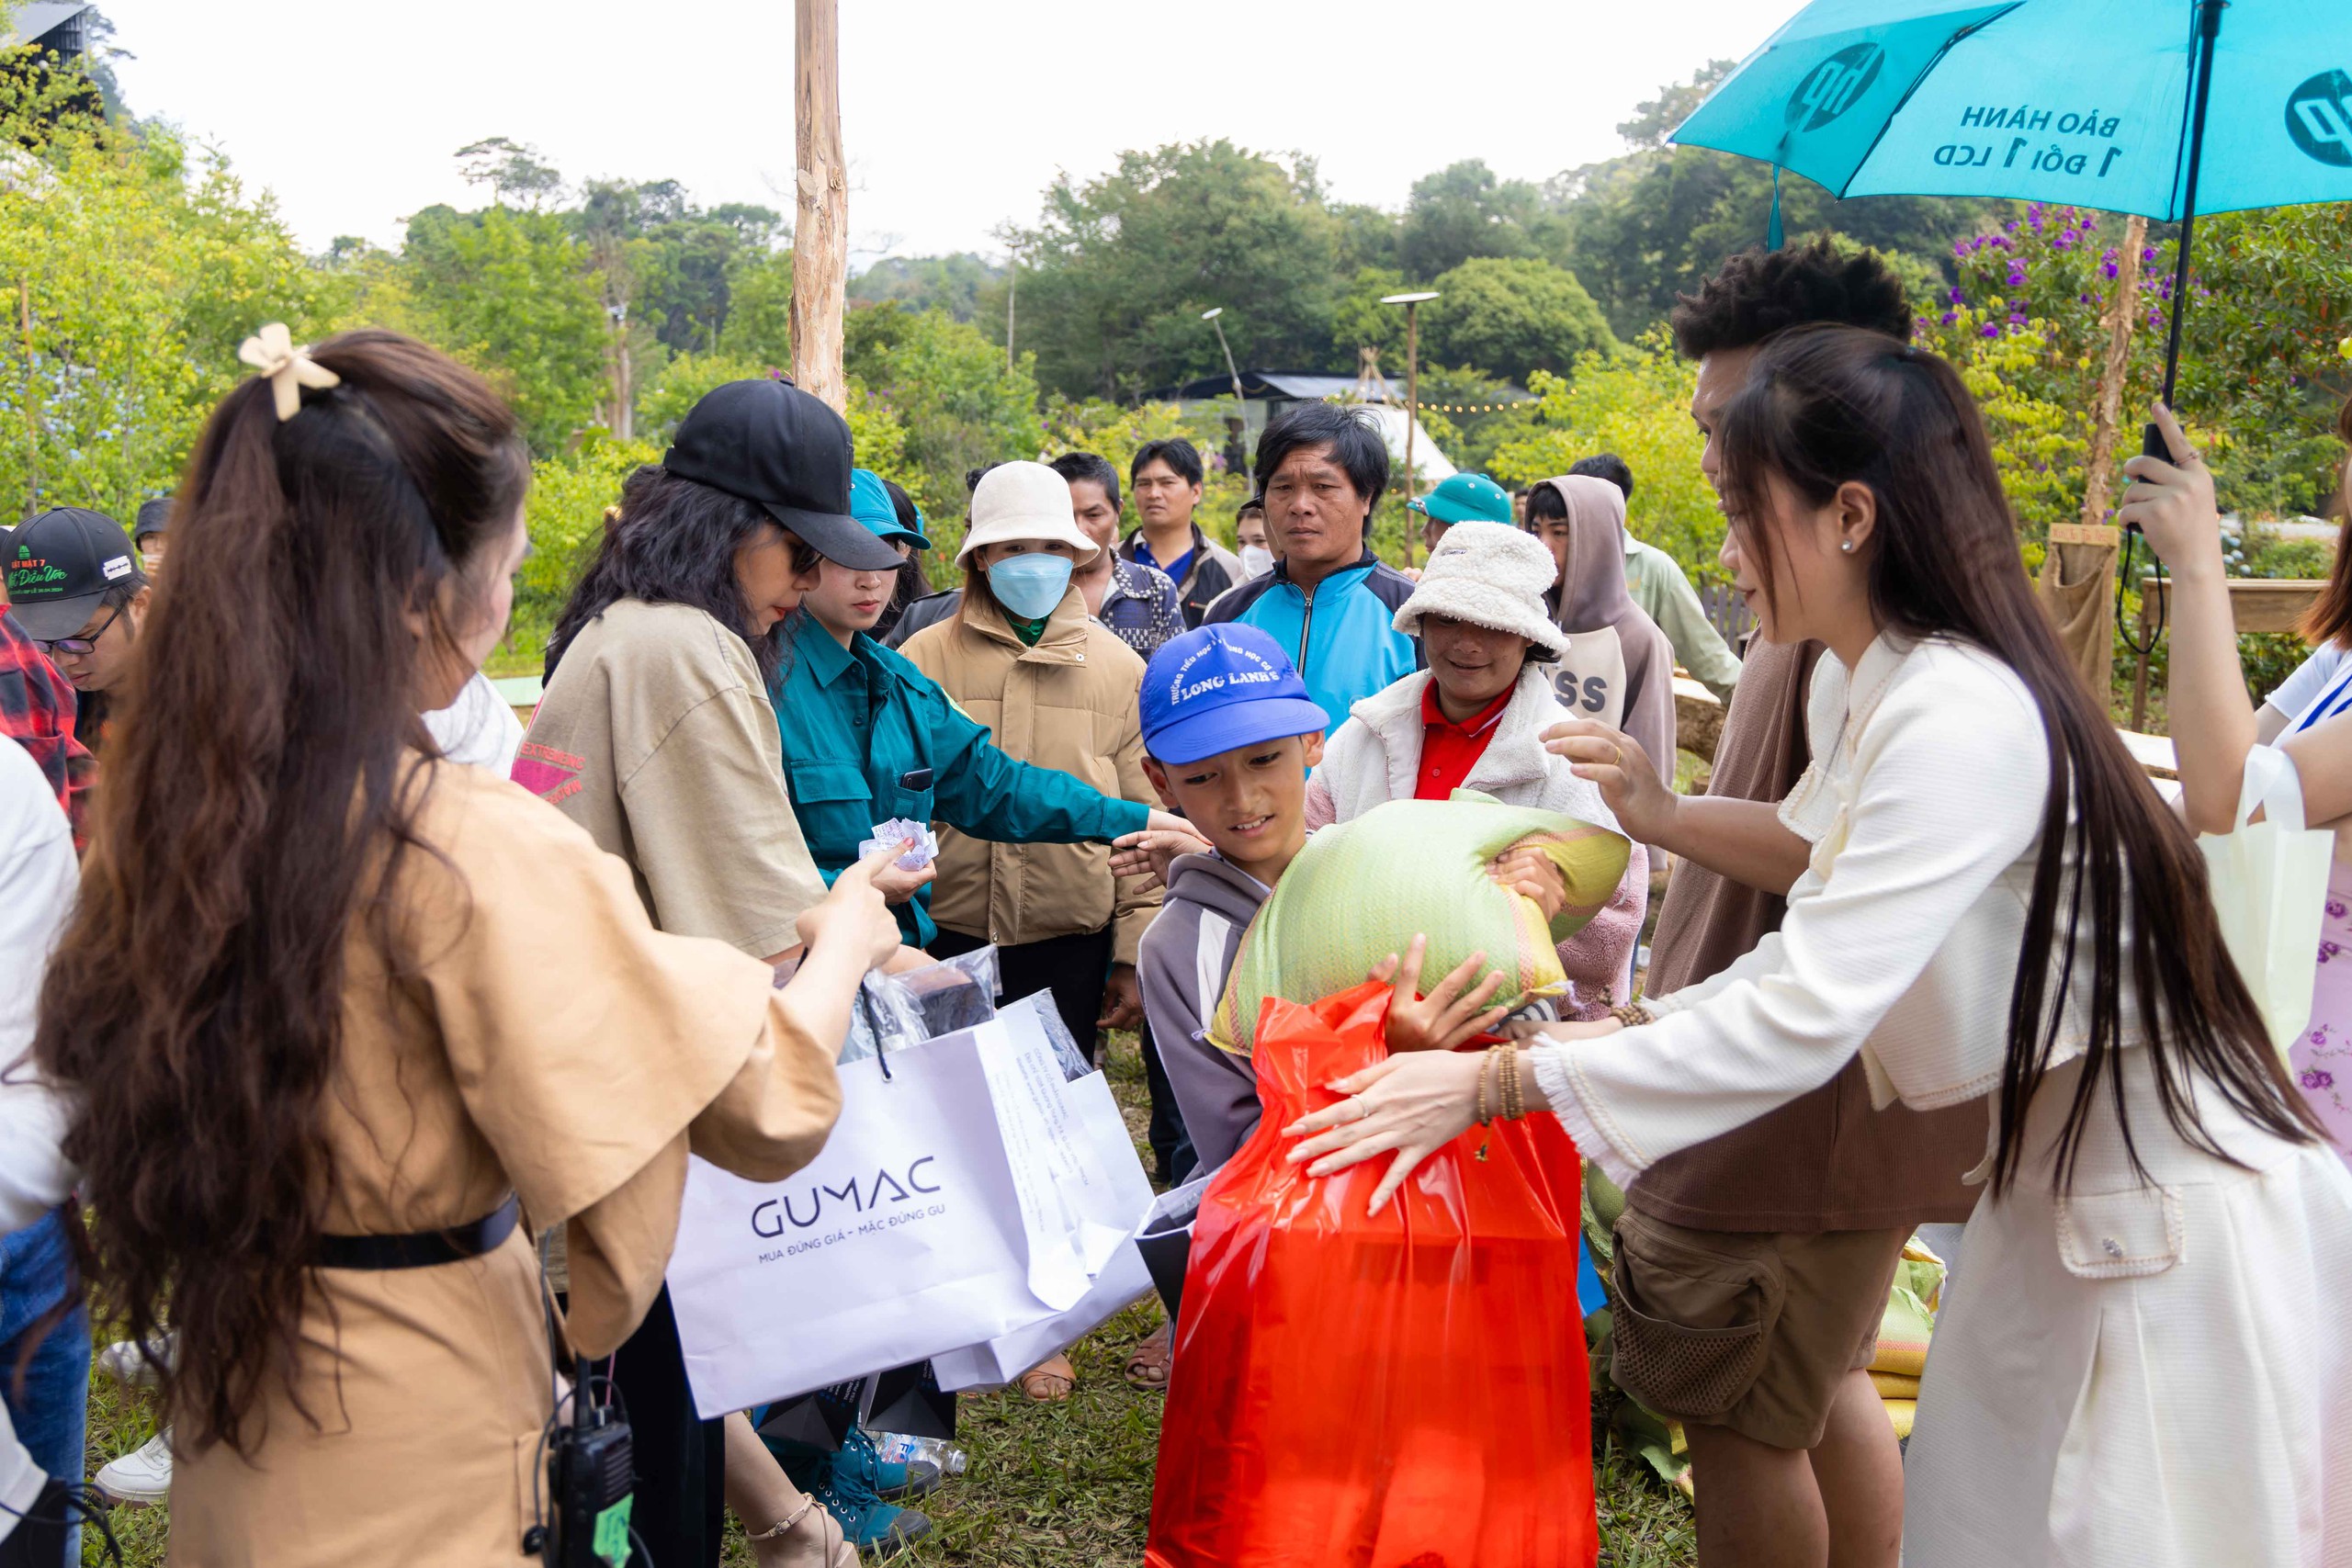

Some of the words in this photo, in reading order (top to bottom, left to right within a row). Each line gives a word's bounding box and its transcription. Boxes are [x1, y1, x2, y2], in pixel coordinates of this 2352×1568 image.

[40, 558, 46, 567] 7
[1196, 644, 1212, 658] HỌC
[1181, 675, 1226, 701] LONG
[752, 1156, 941, 1238] GUMAC
[759, 1248, 785, 1264] MUA
[787, 1239, 821, 1256] ĐÚNG
[824, 1228, 846, 1246] GIÁ
[858, 1219, 885, 1236] MẶC
[888, 1211, 925, 1227] ĐÚNG
[928, 1203, 945, 1216] GU
